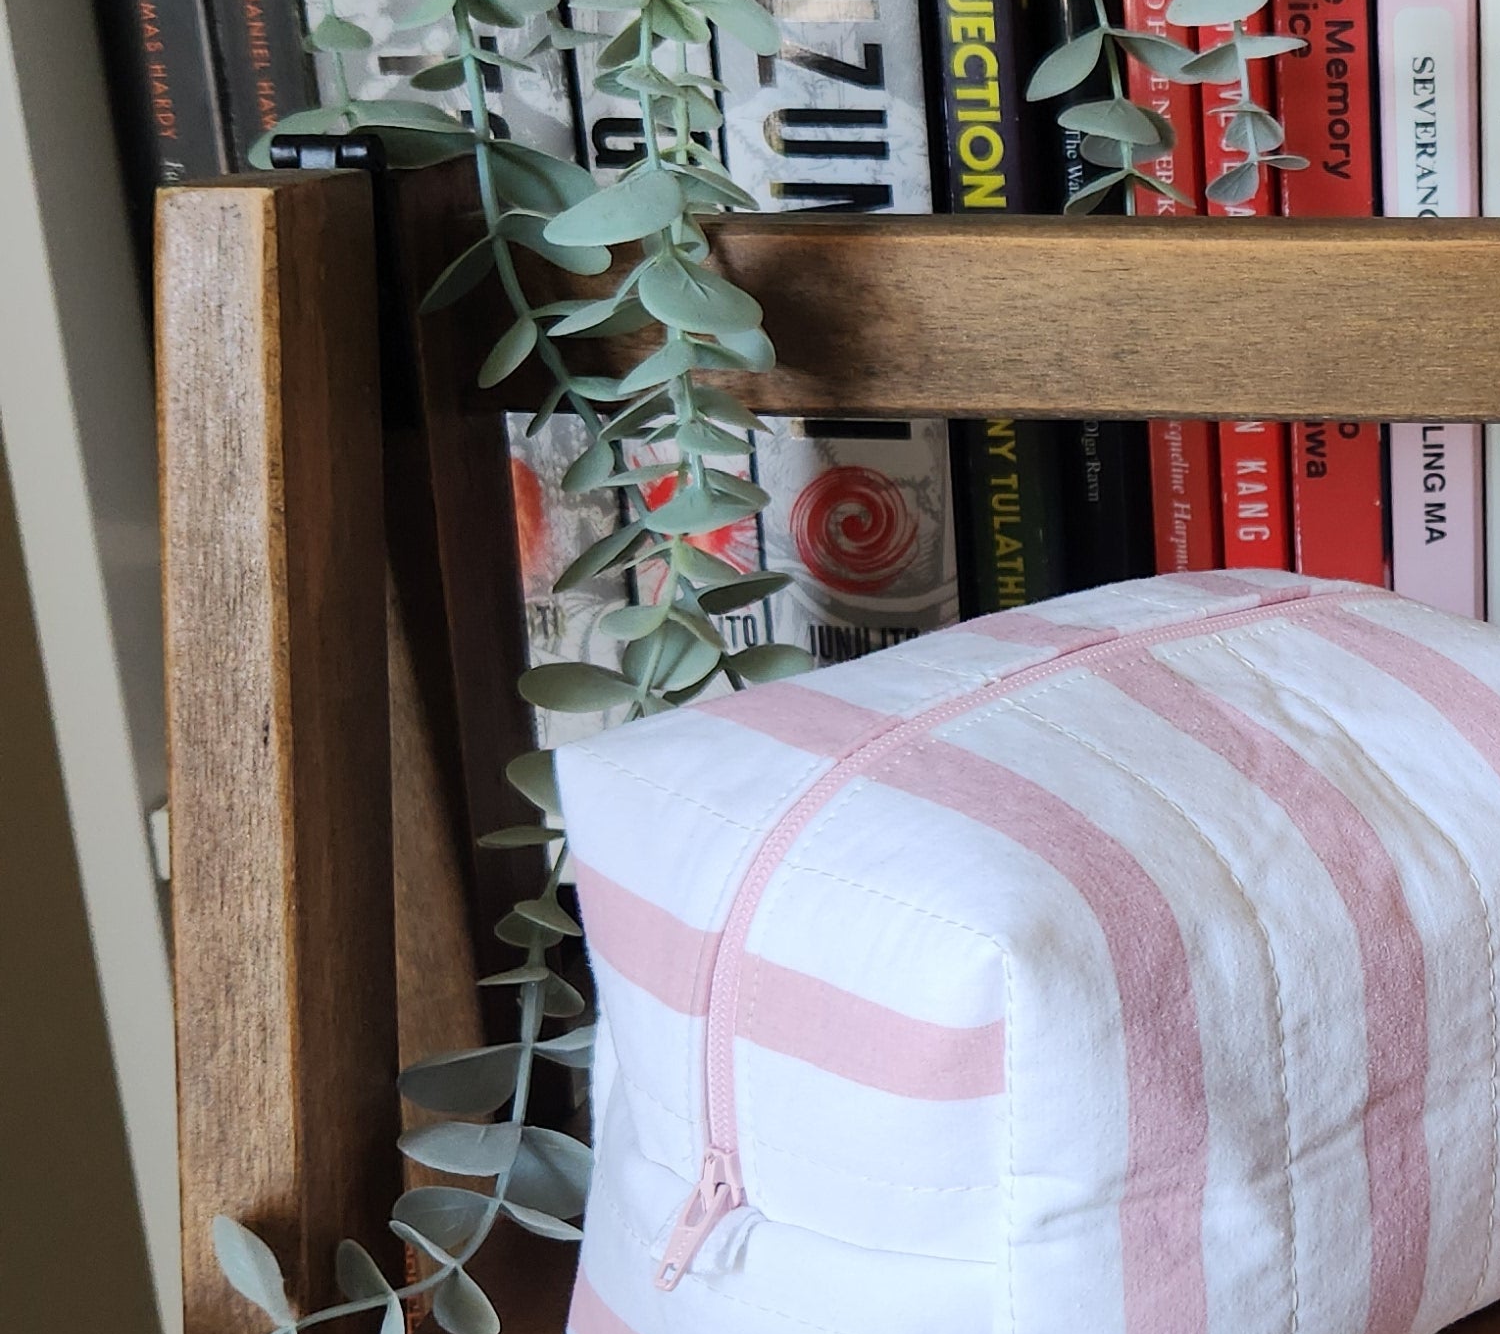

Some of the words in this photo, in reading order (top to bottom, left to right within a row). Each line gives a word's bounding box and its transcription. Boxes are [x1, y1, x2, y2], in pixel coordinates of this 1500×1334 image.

[145, 57, 180, 143] HARDY
[1322, 19, 1355, 181] Memory
[1065, 129, 1081, 166] The
[1085, 458, 1101, 504] Ravn
[1421, 425, 1447, 494] LING
[1235, 458, 1271, 543] KANG
[1423, 502, 1448, 545] MA
